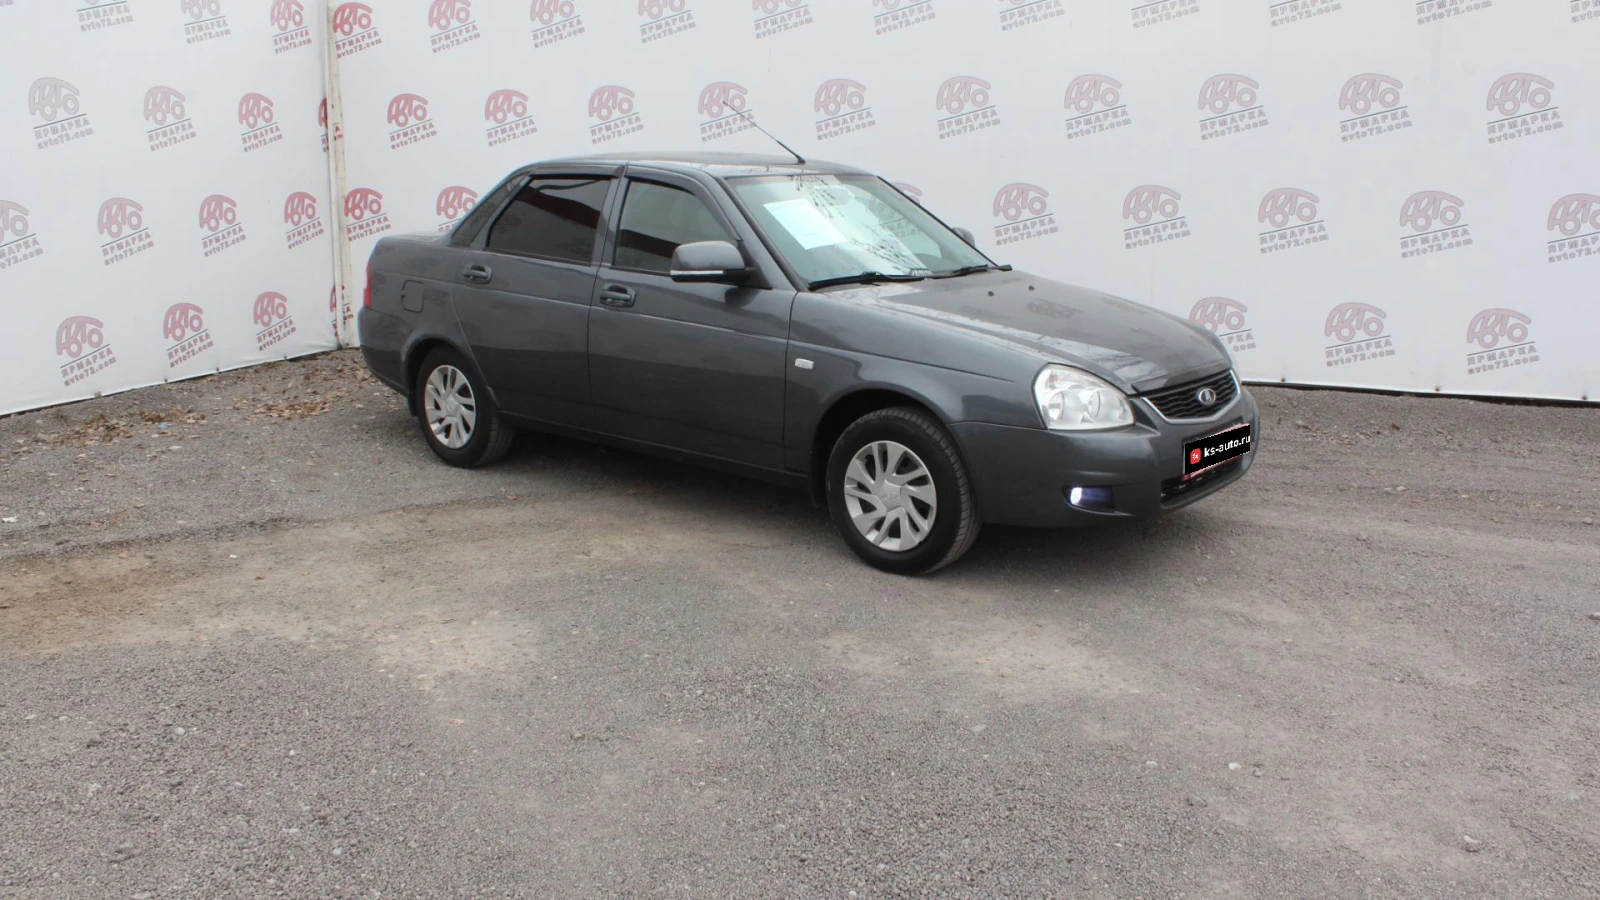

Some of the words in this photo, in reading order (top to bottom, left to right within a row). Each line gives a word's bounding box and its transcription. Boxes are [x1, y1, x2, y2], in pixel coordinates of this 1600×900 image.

[78, 4, 130, 22] ЯРМАРКА
[754, 8, 810, 31] ЯРМАРКА
[874, 3, 932, 27] ЯРМАРКА
[185, 19, 228, 35] ЯРМАРКА
[431, 24, 477, 46] ЯРМАРКА
[533, 19, 582, 40] ЯРМАРКА
[640, 13, 694, 36] ЯРМАРКА
[274, 29, 309, 45] ЯРМАРКА
[336, 31, 379, 52] ЯРМАРКА
[35, 117, 90, 140] ЯРМАРКА
[487, 119, 535, 139] ЯРМАРКА
[591, 116, 641, 136] ЯРМАРКА
[816, 111, 872, 132] ЯРМАРКА
[938, 109, 998, 131] ЯРМАРКА
[1066, 109, 1129, 130] ЯРМАРКА
[1200, 109, 1266, 132] ЯРМАРКА
[1340, 110, 1409, 133] ЯРМАРКА
[1487, 111, 1560, 134] ЯРМАРКА
[148, 122, 193, 142] ЯРМАРКА
[242, 125, 280, 144] ЯРМАРКА
[390, 121, 434, 142] ЯРМАРКА
[287, 221, 322, 241] ЯРМАРКА
[347, 216, 389, 236] ЯРМАРКА
[995, 217, 1055, 237] ЯРМАРКА
[1124, 220, 1187, 240] ЯРМАРКА
[1259, 224, 1325, 245] ЯРМАРКА
[102, 232, 151, 257] ЯРМАРКА
[202, 226, 243, 249] ЯРМАРКА
[1401, 228, 1469, 249] ЯРМАРКА
[1548, 236, 1599, 253] ЯРМАР
[0, 238, 39, 259] МАРКА
[1548, 247, 1600, 263] avto72.
[257, 319, 293, 343] ЯРМАРКА
[168, 333, 210, 359] ЯРМАРКА
[1325, 339, 1392, 358] ЯРМАРКА
[1467, 345, 1536, 365] ЯРМАРКА
[61, 348, 113, 378] ЯРМАРКА
